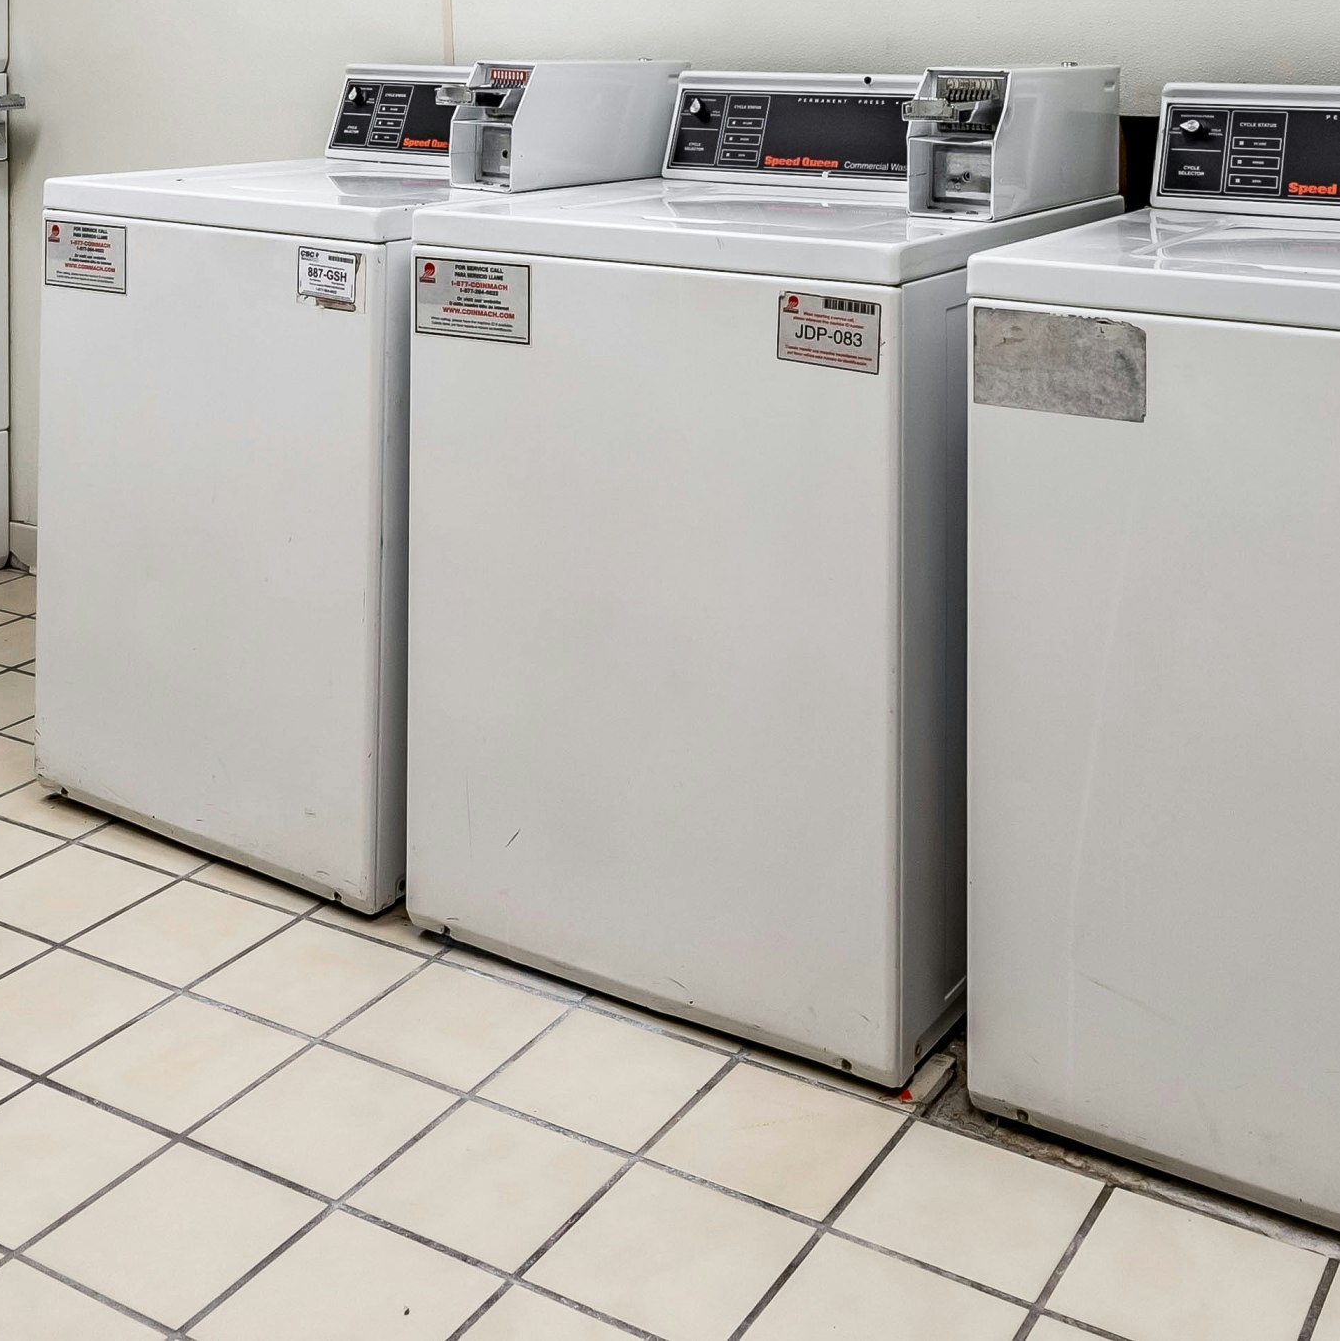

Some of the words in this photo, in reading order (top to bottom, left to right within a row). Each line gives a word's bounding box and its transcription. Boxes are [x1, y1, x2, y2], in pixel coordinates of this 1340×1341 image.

[403, 138, 430, 147] Speed
[432, 139, 448, 148] Que
[765, 156, 800, 166] Speed
[802, 157, 839, 168] Queen
[844, 161, 889, 170] Commercial
[891, 163, 907, 171] Was
[1288, 182, 1337, 196] Speed
[308, 267, 347, 282] 887-GSH
[451, 281, 507, 290] 1-877-COINMACH
[443, 307, 515, 319] WWW.COINMACH.COM
[795, 324, 863, 348] JDP-083
